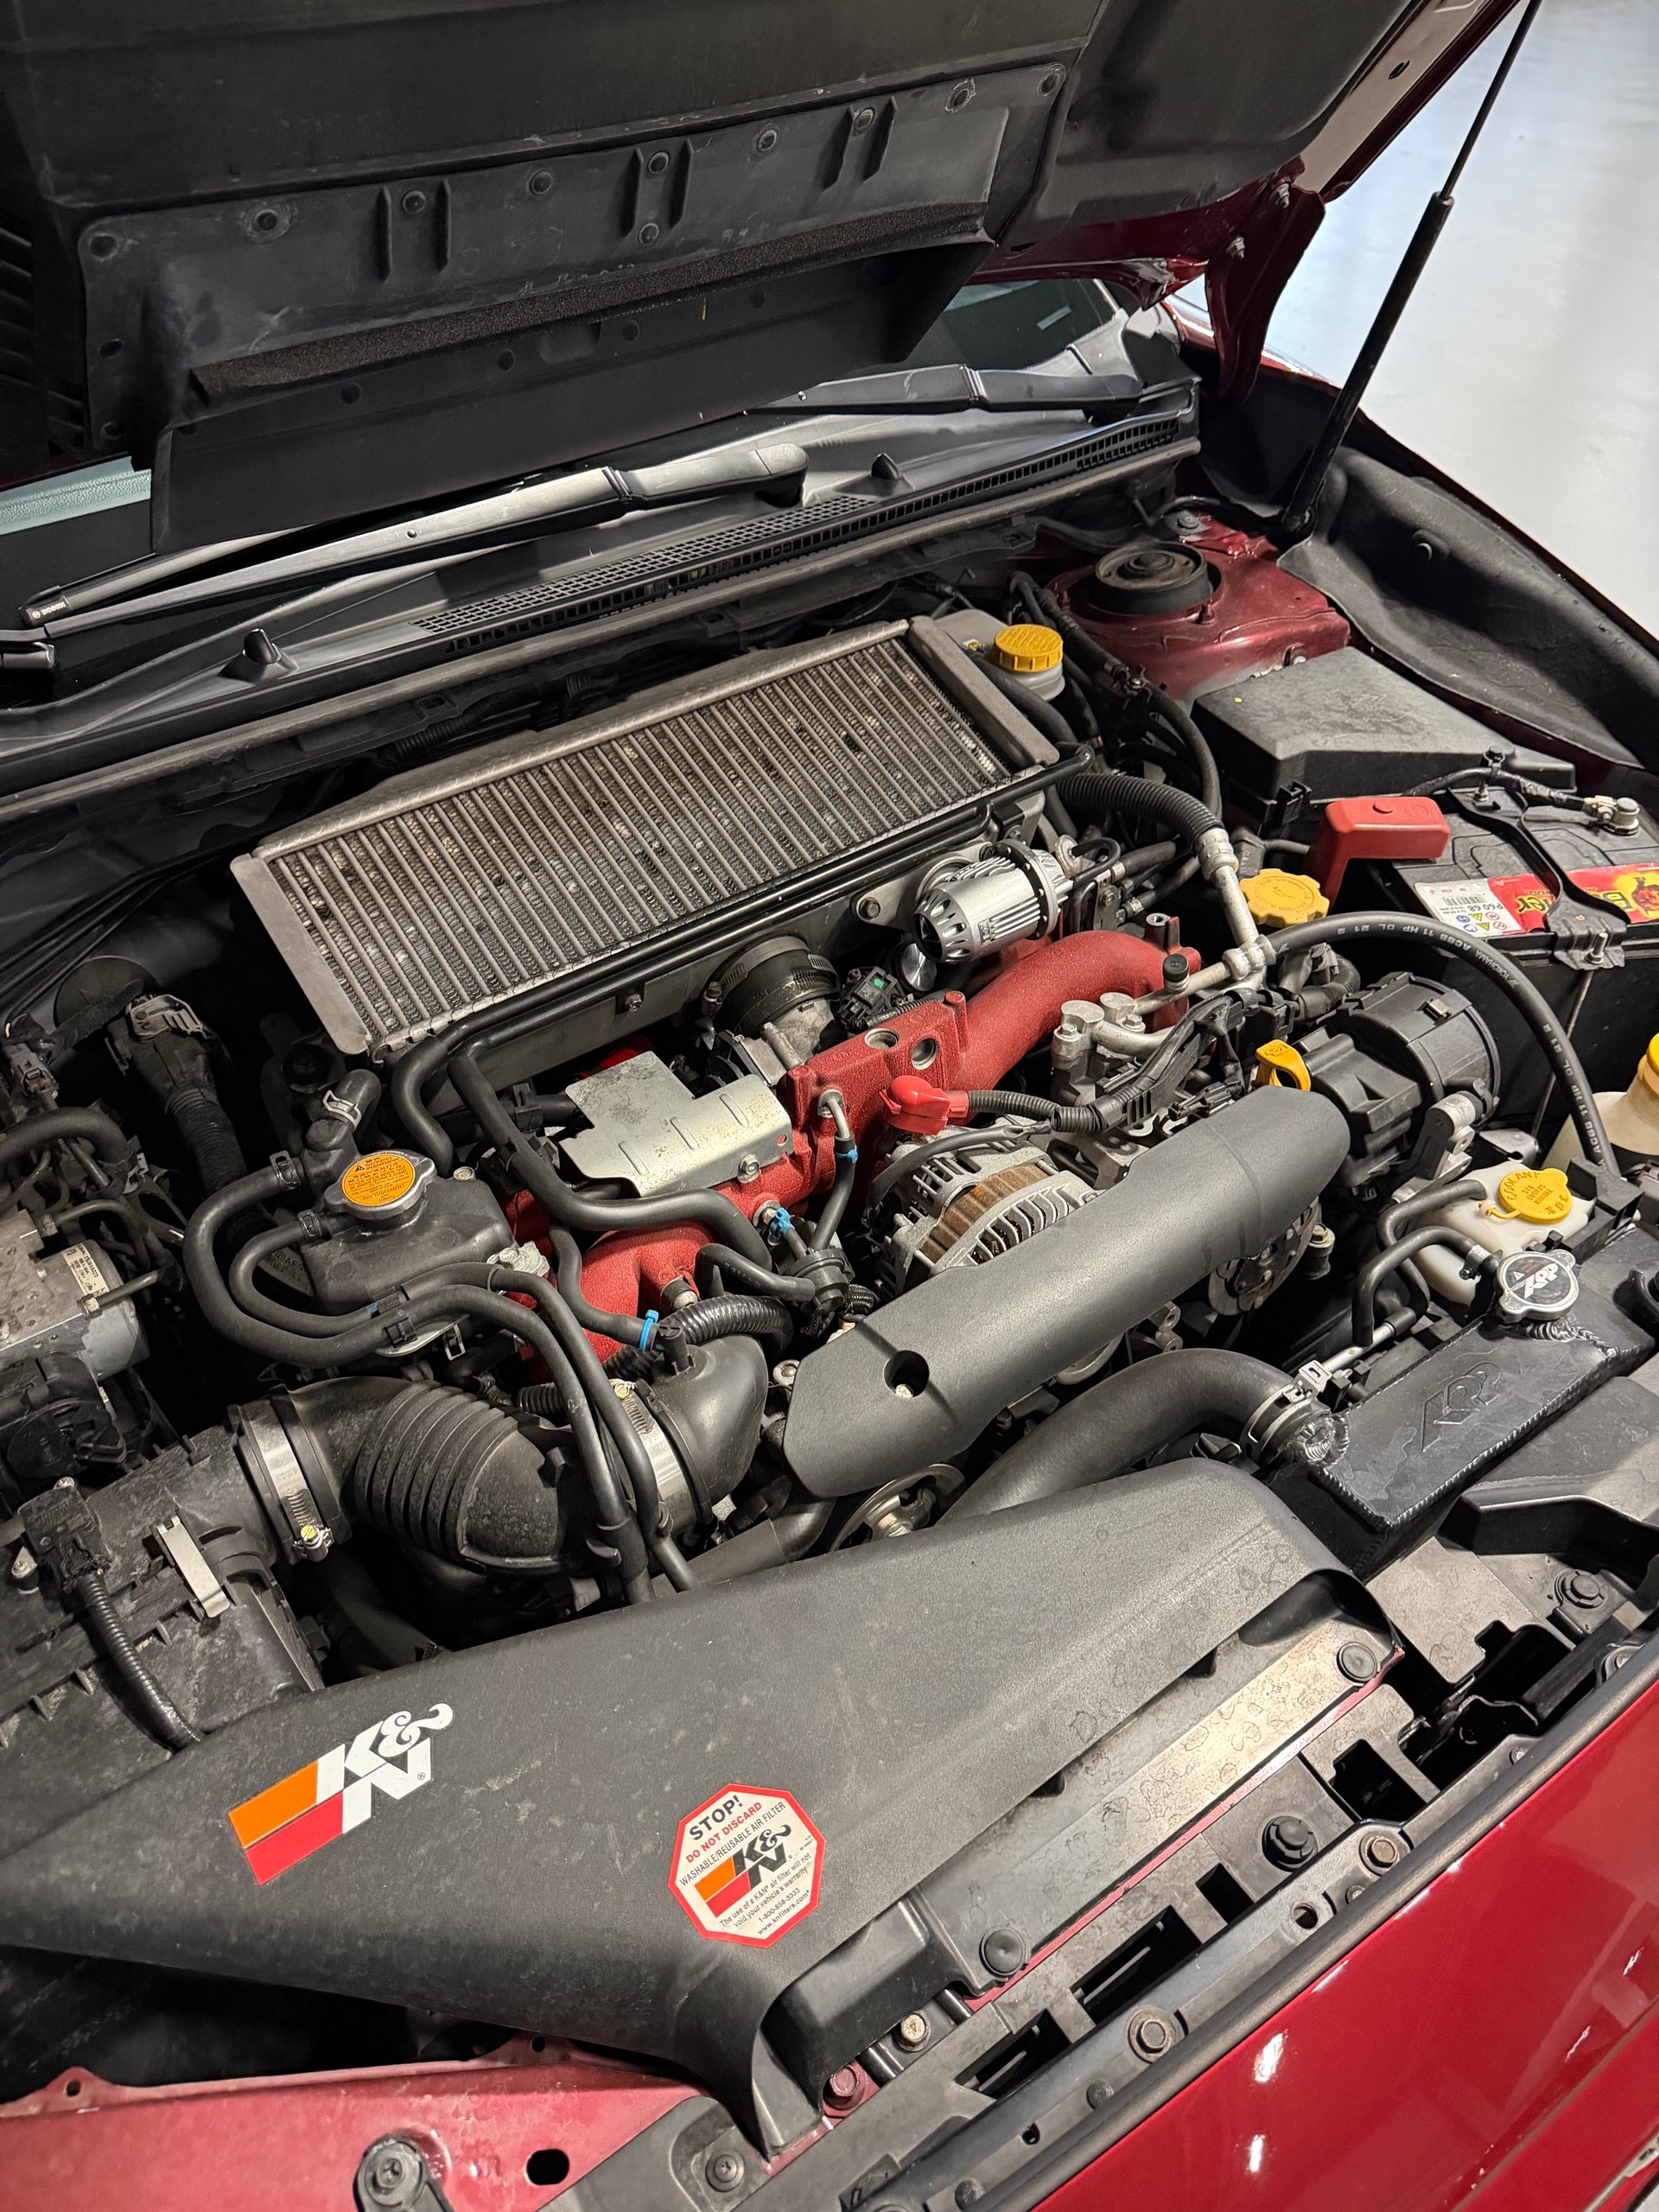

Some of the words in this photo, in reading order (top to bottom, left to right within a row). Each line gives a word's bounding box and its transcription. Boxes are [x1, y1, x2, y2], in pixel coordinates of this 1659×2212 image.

[1474, 950, 1510, 980] YOKOHAMA
[1563, 1059, 1573, 1077] DL
[1503, 1172, 1540, 1200] COOLANT
[686, 1850, 701, 1863] DO
[702, 1834, 721, 1852] NOT
[722, 1802, 762, 1835] DISCARD
[689, 1795, 743, 1840] STOP!
[679, 1827, 752, 1886] WASHABLE/REUSABLE
[752, 1817, 764, 1832] AIR
[763, 1802, 785, 1824] FILTER
[720, 1916, 733, 1928] The
[732, 1908, 743, 1919] use
[743, 1901, 751, 1910] of
[770, 1879, 779, 1890] air
[778, 1868, 791, 1884] filter
[791, 1861, 801, 1873] will
[800, 1853, 811, 1866] not
[734, 1917, 747, 1928] void
[747, 1907, 760, 1920] your
[760, 1886, 785, 1908] vehicle's
[783, 1866, 808, 1891] warranty
[758, 1887, 800, 1923] 1-800-858-3333
